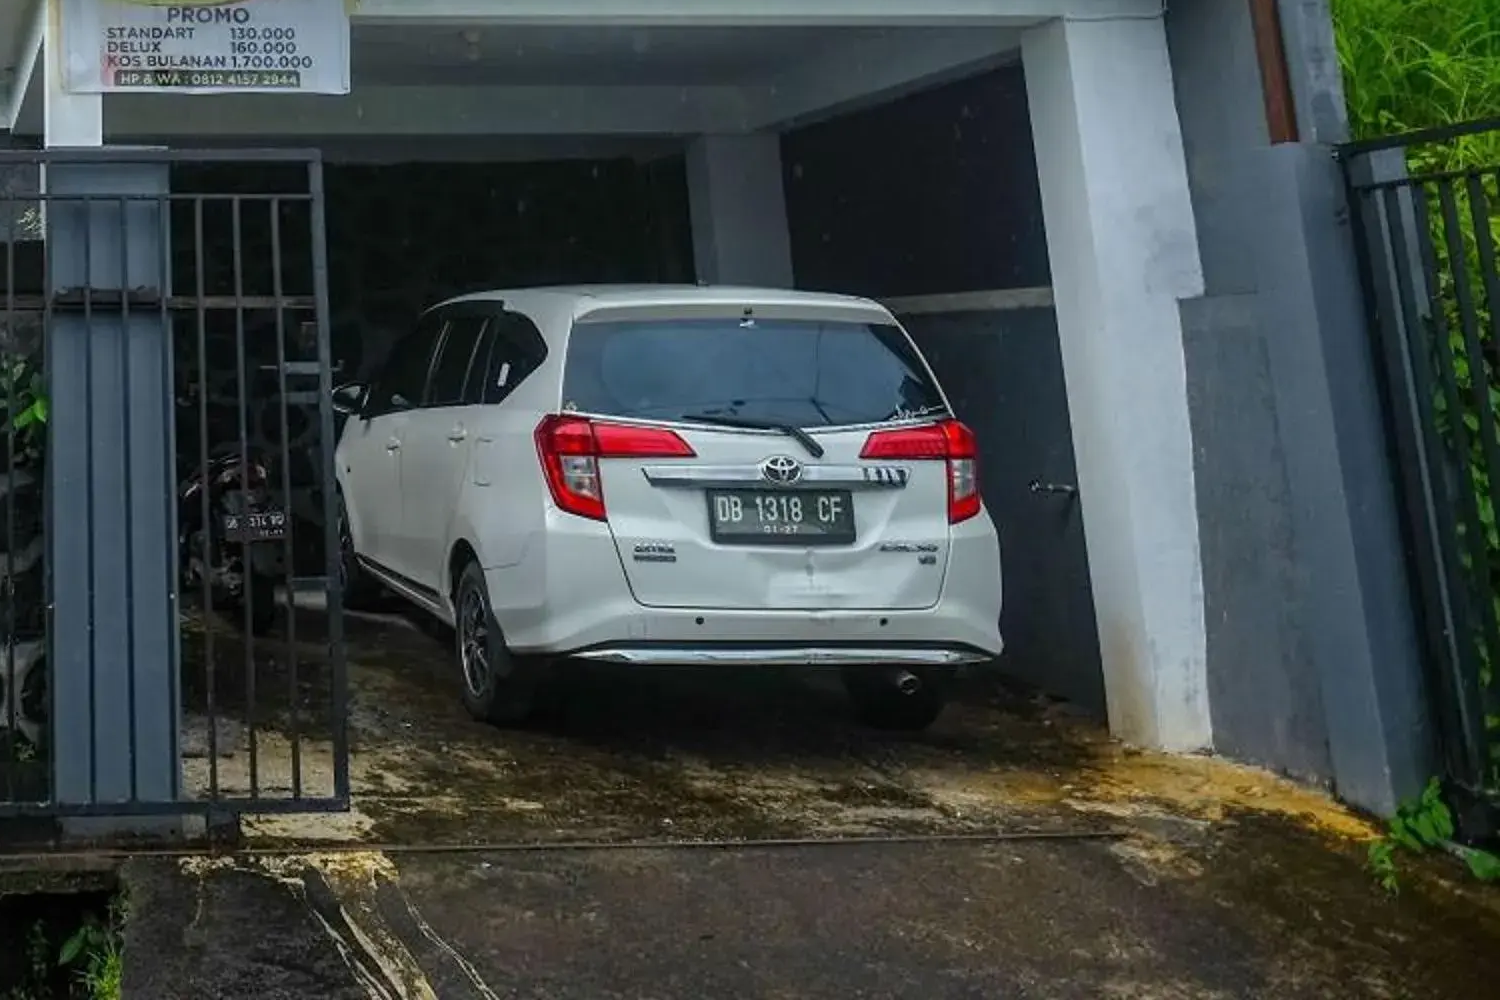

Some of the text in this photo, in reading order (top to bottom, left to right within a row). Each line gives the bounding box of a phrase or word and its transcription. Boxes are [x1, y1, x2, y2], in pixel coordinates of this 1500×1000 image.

[166, 7, 251, 24] PROMO
[106, 27, 296, 40] STANDART 130.000
[106, 41, 297, 54] DELUX 160.000
[106, 55, 313, 69] KOS BULANAN 1.700.000
[120, 73, 140, 85] HP
[155, 73, 181, 85] WA
[191, 73, 224, 85] 0812
[716, 495, 843, 523] DB 1318 CF
